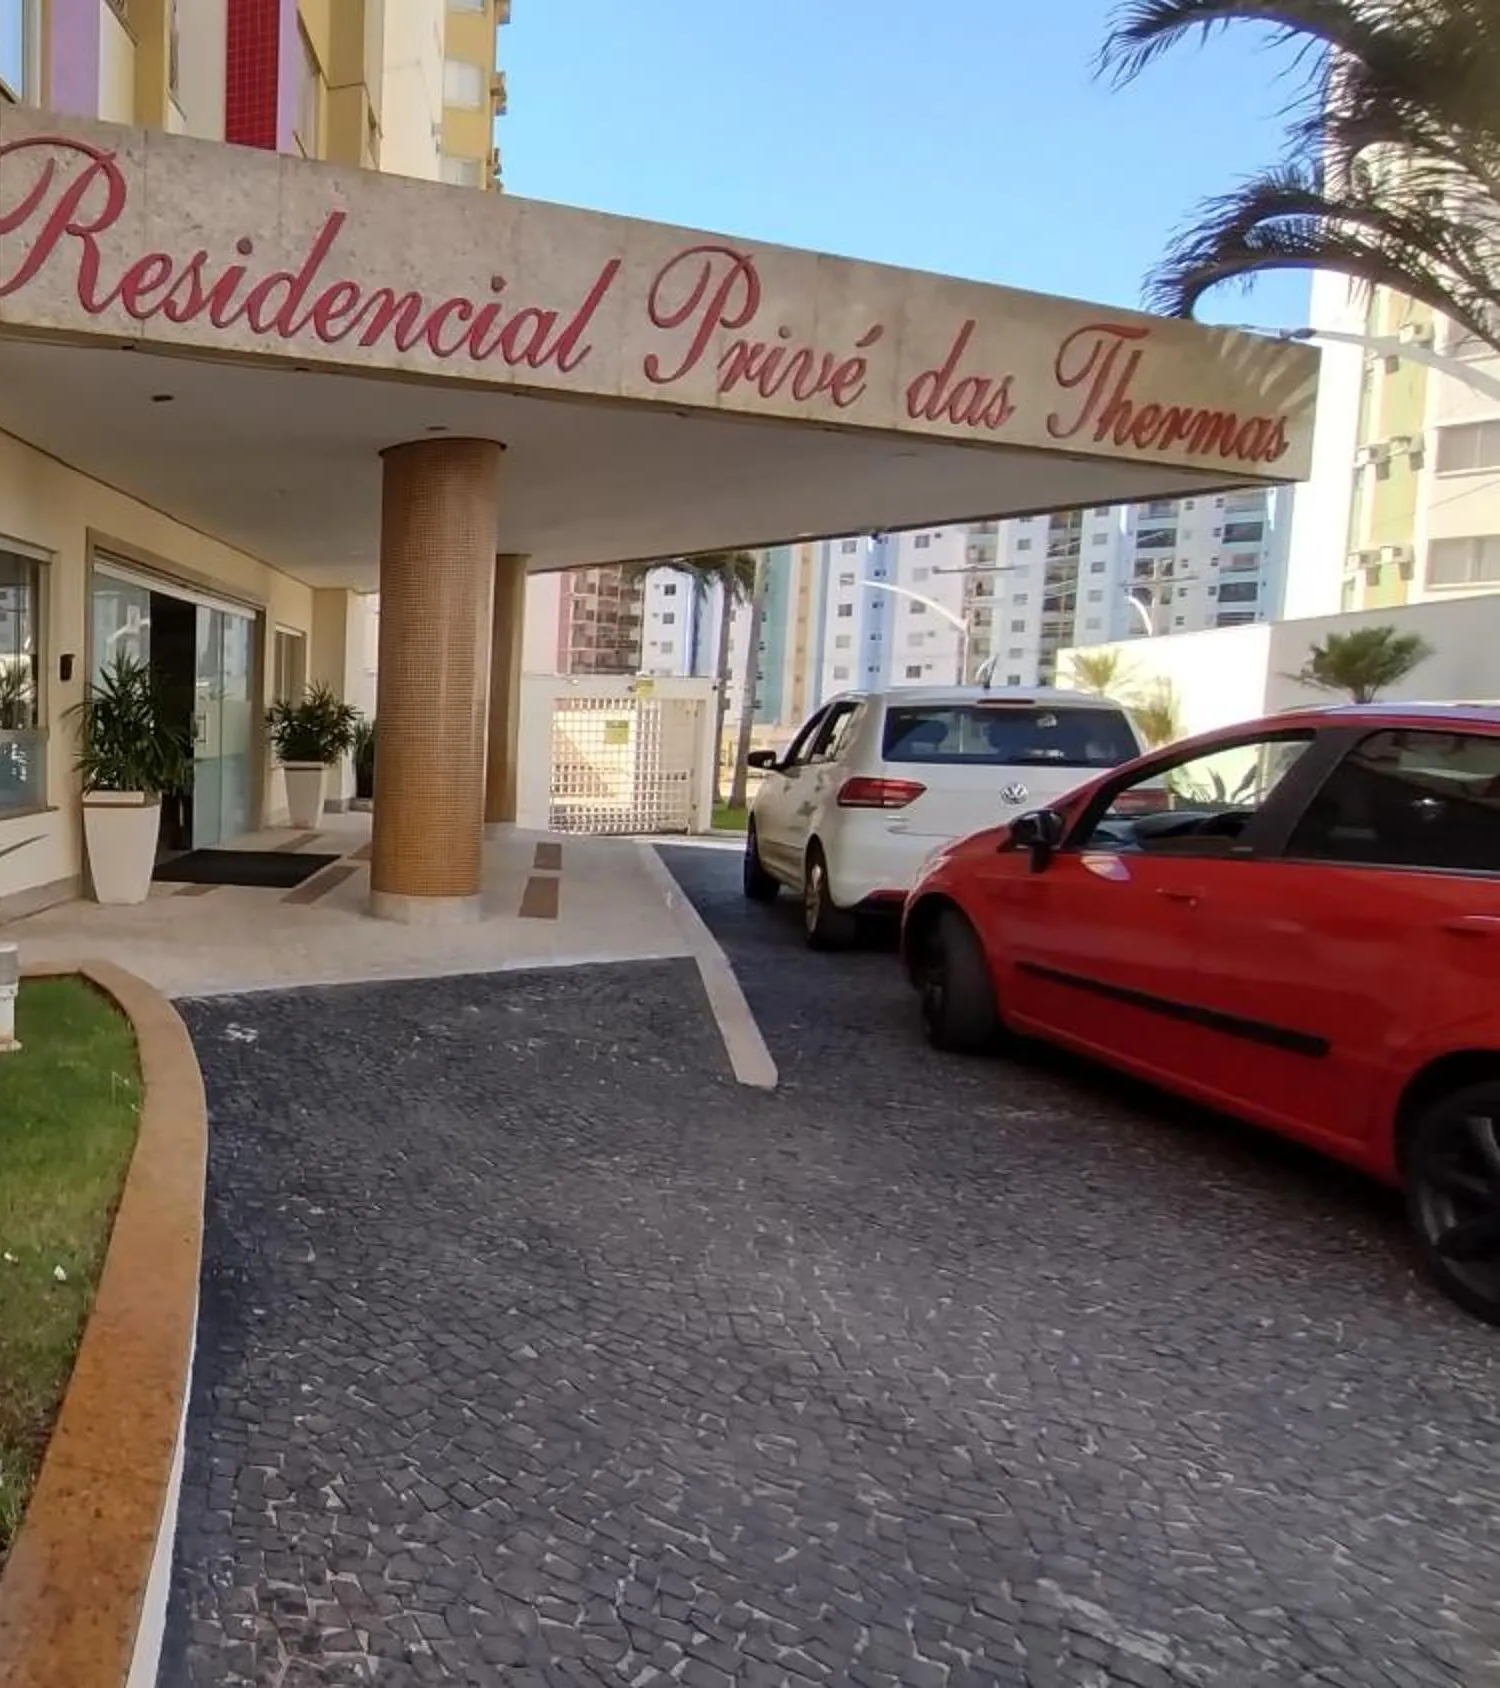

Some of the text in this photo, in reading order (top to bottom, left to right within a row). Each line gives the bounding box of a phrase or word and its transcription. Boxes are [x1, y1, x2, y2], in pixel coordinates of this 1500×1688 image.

[644, 246, 885, 409] Privé
[907, 320, 1016, 429] das
[1047, 323, 1290, 463] Thermas
